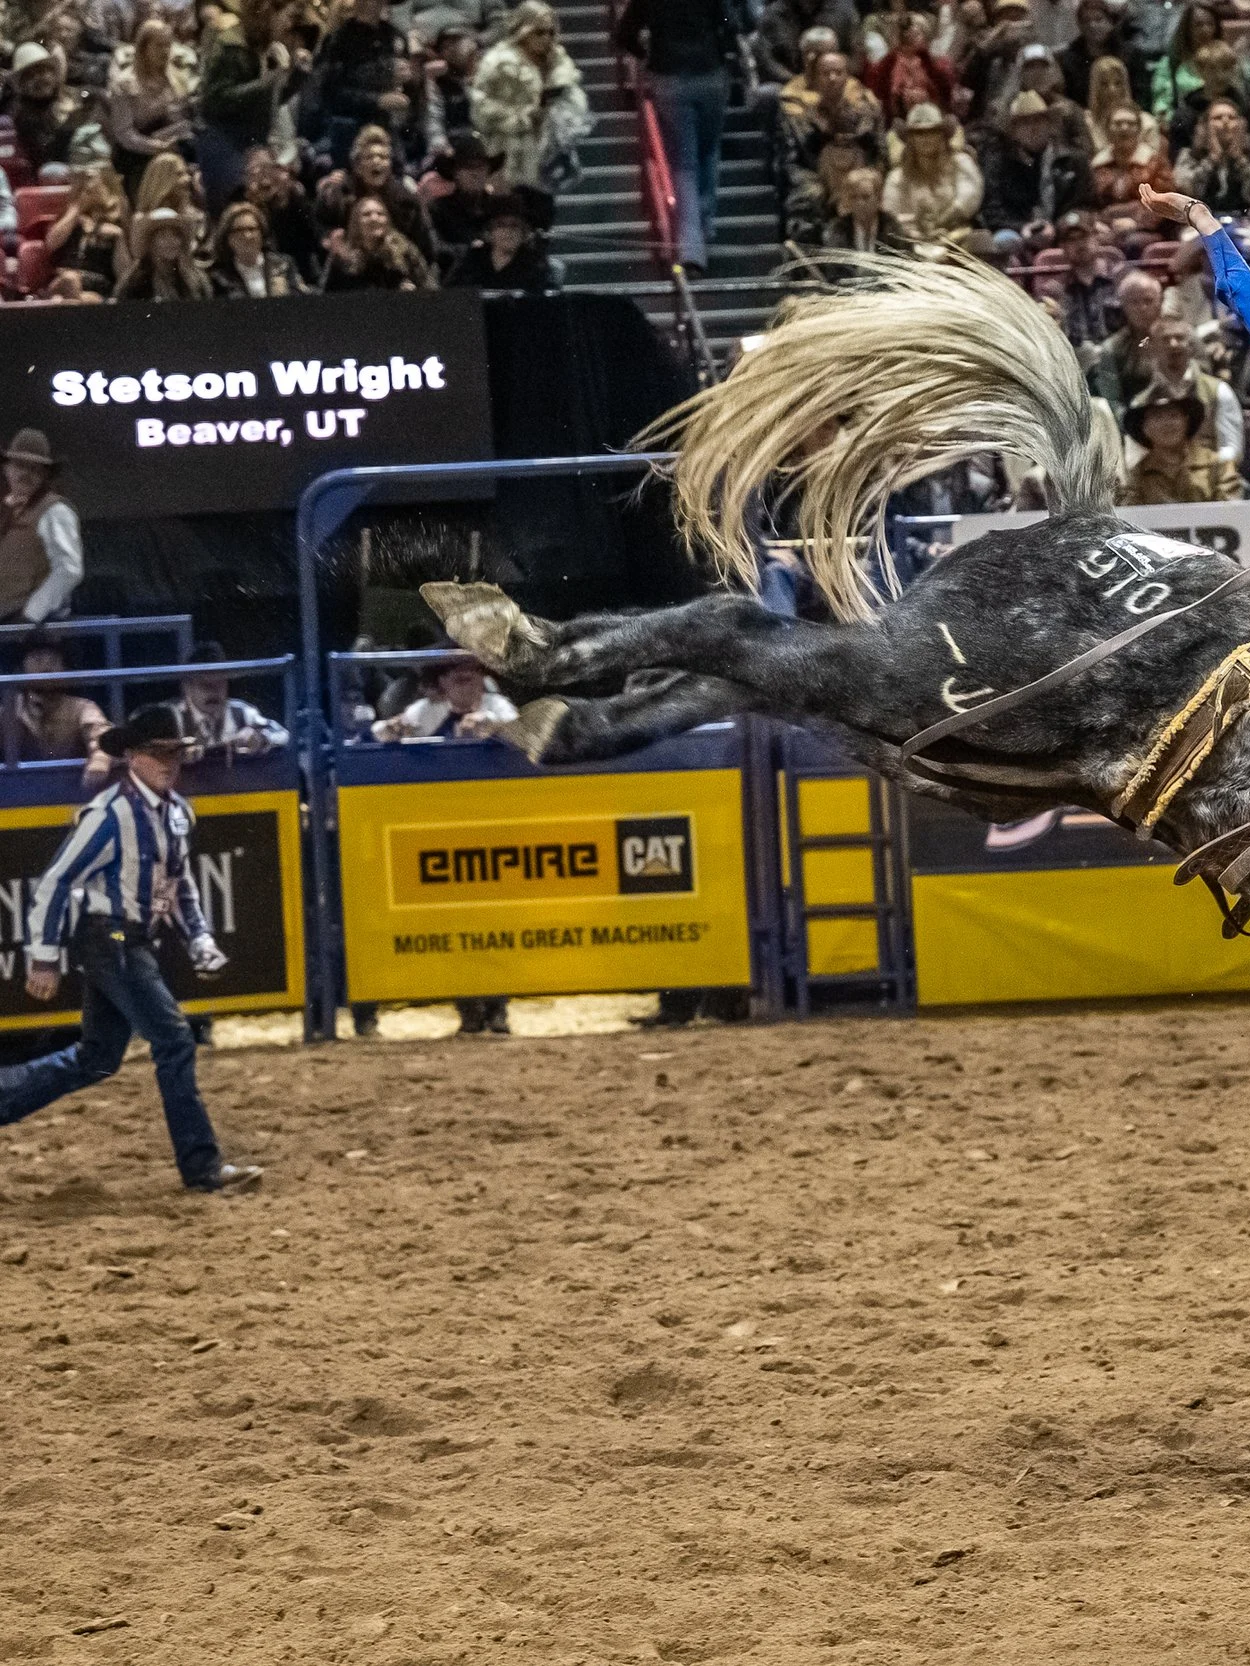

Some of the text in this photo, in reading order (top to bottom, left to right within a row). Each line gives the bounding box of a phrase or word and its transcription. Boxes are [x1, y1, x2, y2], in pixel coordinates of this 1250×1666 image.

[51, 356, 446, 405] Stetson Wright
[135, 408, 368, 447] Beaver, UT
[419, 835, 685, 884] EMPIRE CAT
[393, 932, 452, 954] MORE
[457, 929, 515, 951] THAN
[521, 926, 584, 949] GREAT
